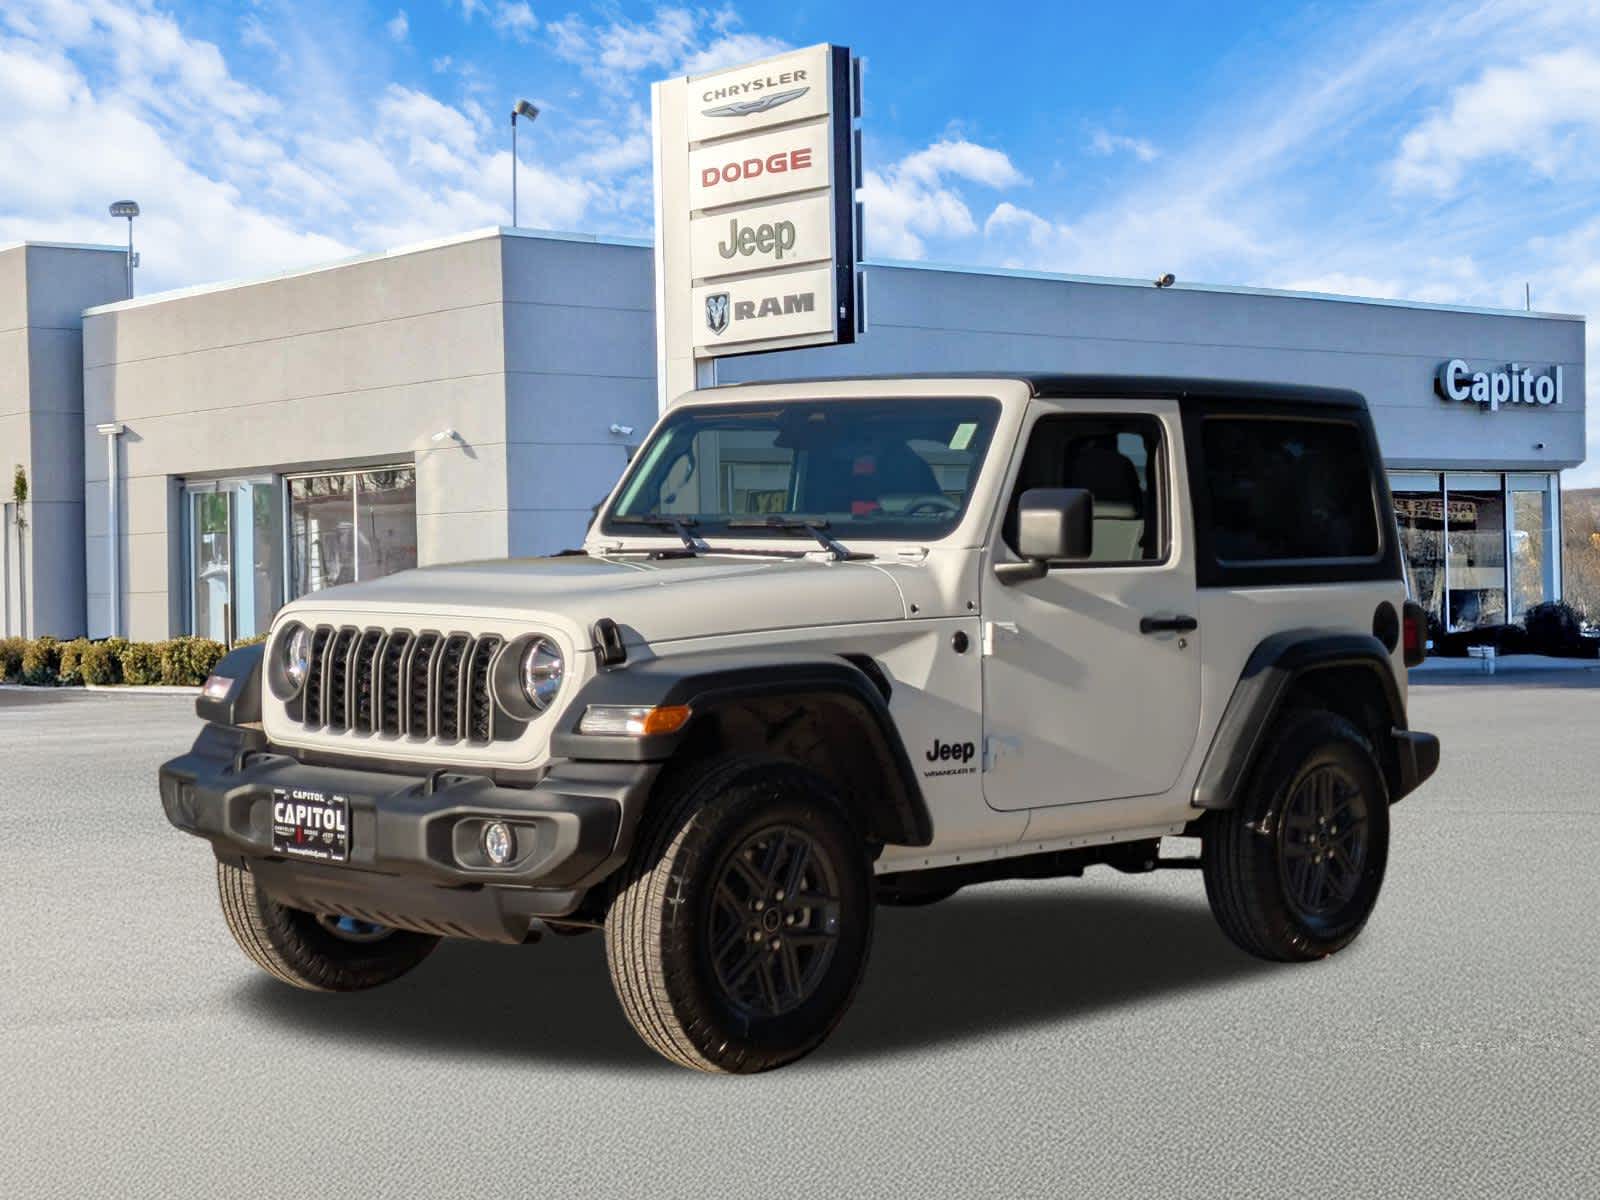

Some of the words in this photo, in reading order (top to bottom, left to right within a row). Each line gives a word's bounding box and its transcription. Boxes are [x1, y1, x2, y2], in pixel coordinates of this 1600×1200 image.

[702, 70, 808, 102] CHRYSLER
[702, 148, 813, 187] DODGE
[718, 218, 796, 260] Jeep
[734, 292, 815, 321] RAM
[1446, 359, 1564, 411] Capitol
[926, 739, 975, 764] Jeep
[292, 790, 326, 802] CAPITOL
[274, 802, 346, 831] CAPITOL
